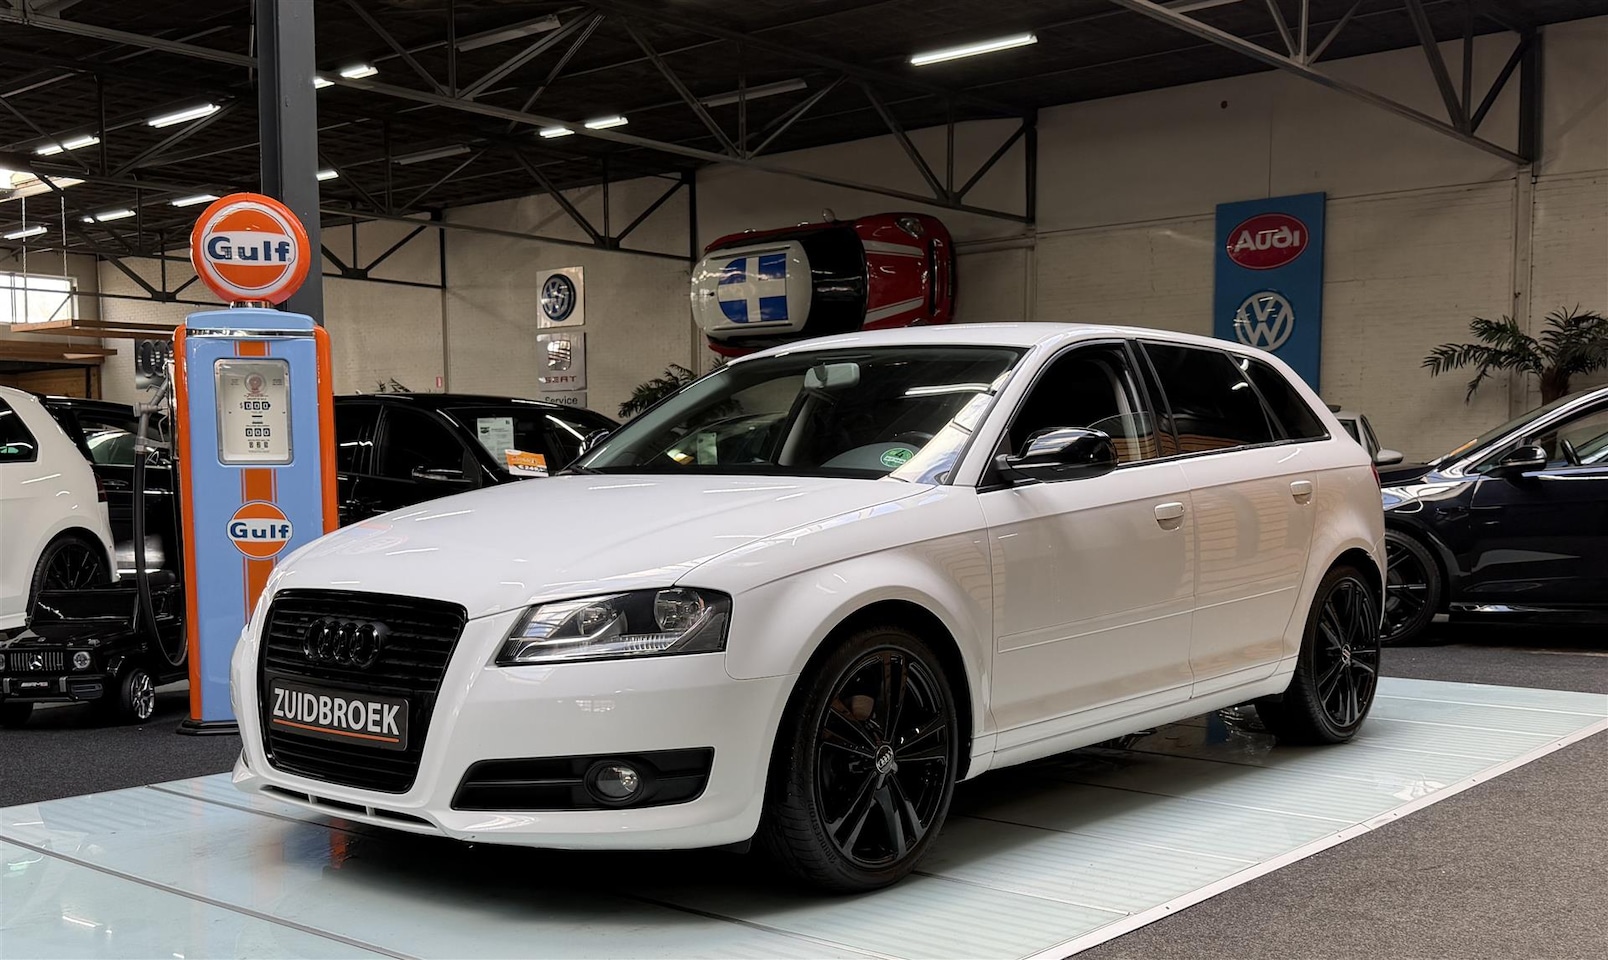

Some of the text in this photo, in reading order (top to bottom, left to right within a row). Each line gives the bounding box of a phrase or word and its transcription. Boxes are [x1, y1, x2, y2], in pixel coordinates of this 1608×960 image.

[207, 236, 290, 262] Gulf
[545, 375, 577, 383] SEAT
[544, 395, 578, 405] Service
[230, 522, 290, 539] Gulf
[273, 687, 400, 735] ZUIDBROEK
